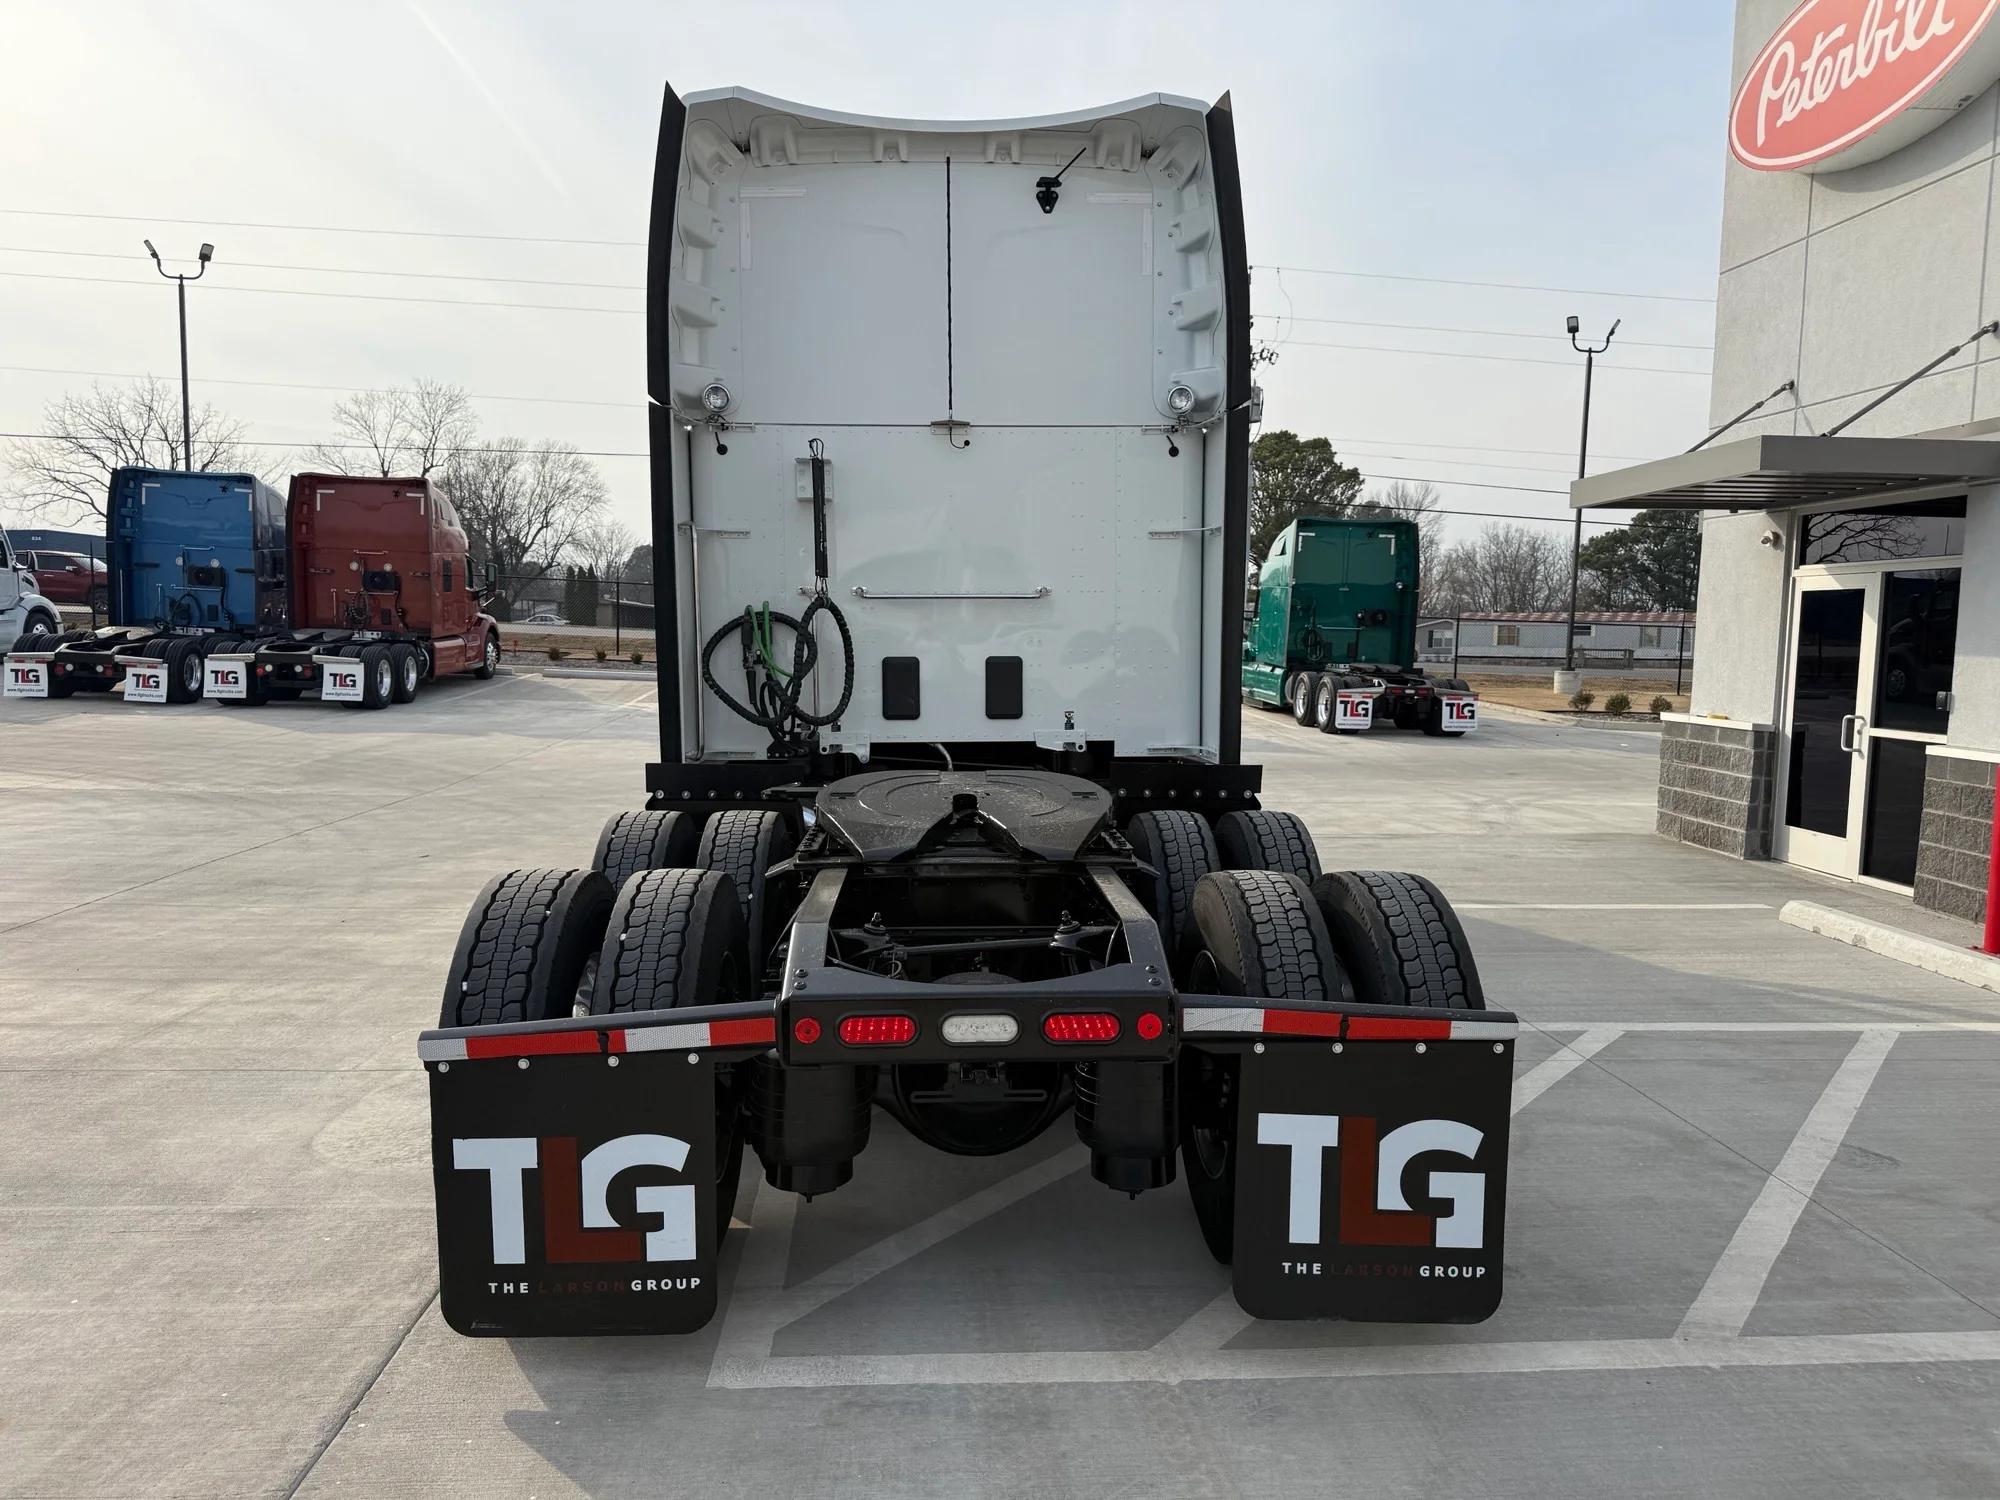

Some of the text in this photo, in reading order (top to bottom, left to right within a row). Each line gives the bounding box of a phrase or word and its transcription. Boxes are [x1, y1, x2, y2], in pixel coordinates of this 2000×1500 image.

[10, 668, 40, 684] TLG
[132, 673, 160, 689] TLG
[210, 670, 239, 685] TLG
[329, 673, 357, 688] TLG
[1339, 700, 1369, 718] TLG
[1445, 702, 1475, 720] TLG
[1257, 1112, 1486, 1249] TLG
[452, 1133, 697, 1265] TLG
[1282, 1262, 1486, 1278] THE LARSON GROUP
[488, 1277, 701, 1295] THE LARSON GROUP
